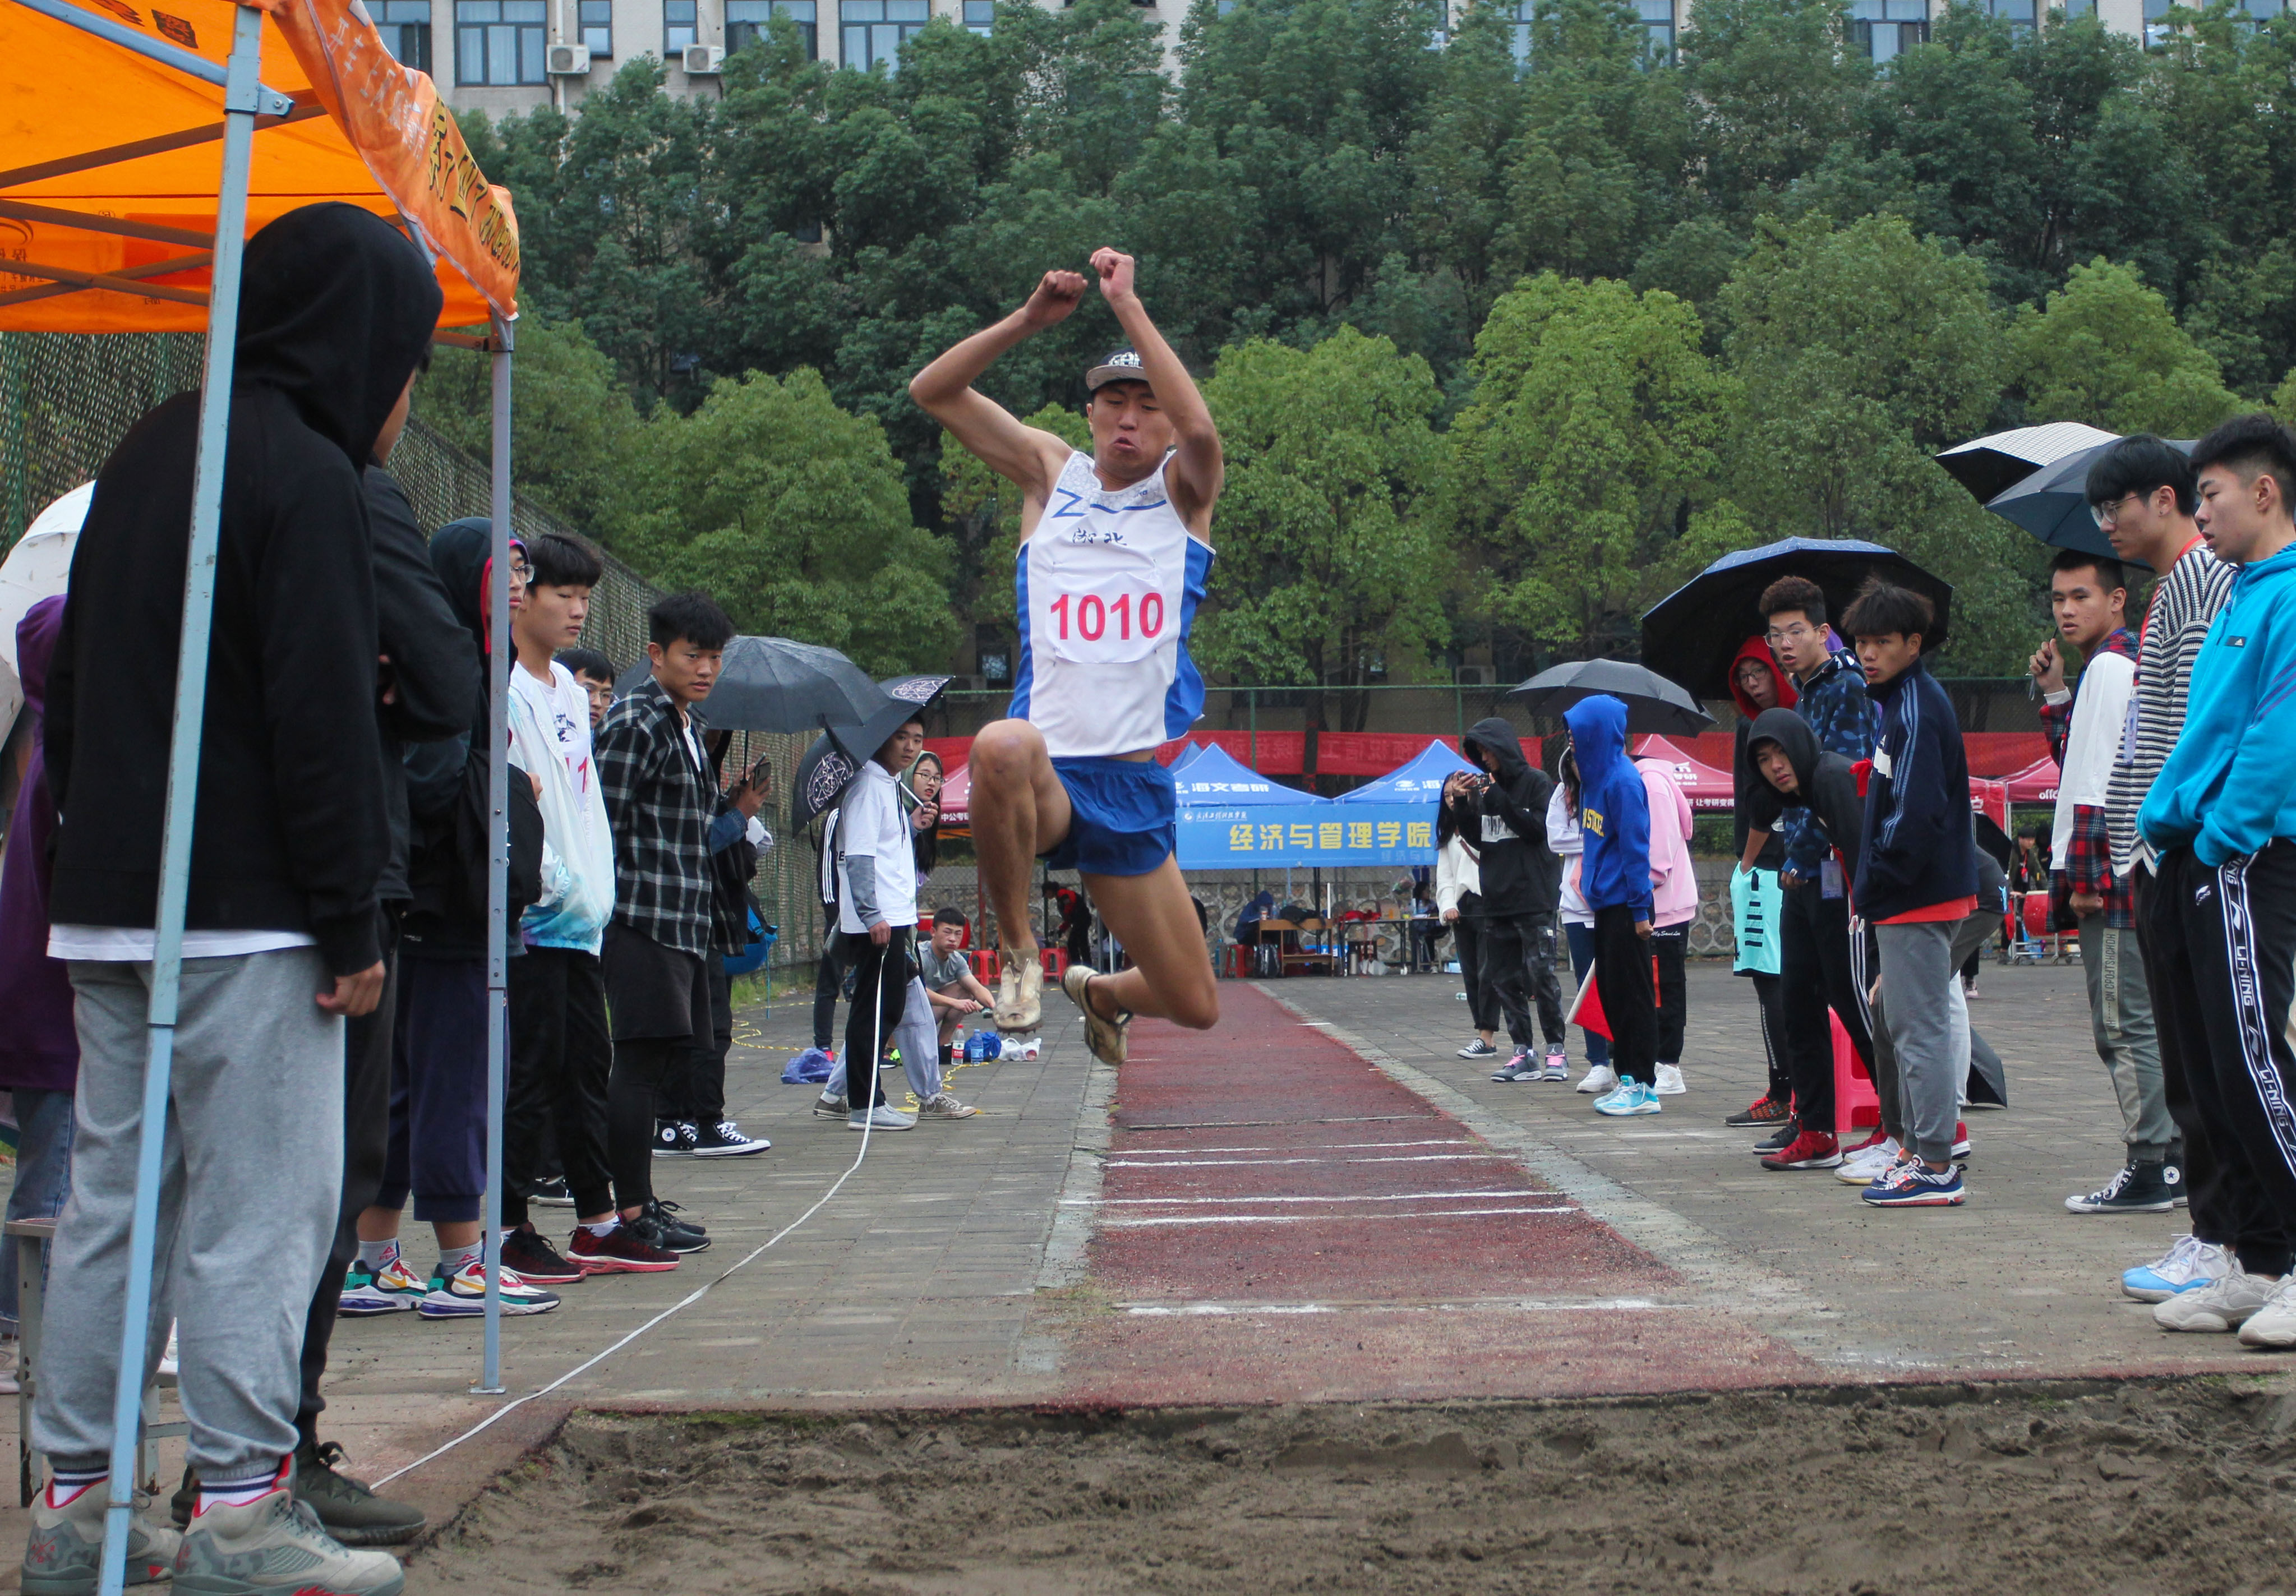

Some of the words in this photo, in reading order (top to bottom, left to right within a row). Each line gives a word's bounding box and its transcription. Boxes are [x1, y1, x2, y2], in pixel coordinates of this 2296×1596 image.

[1050, 592, 1164, 642] 1010
[1192, 782, 1270, 793] 海文考研
[1229, 822, 1431, 851] 经济与管理学院
[2237, 945, 2253, 1007] LI-NING
[2259, 1069, 2289, 1128] LI-NING
